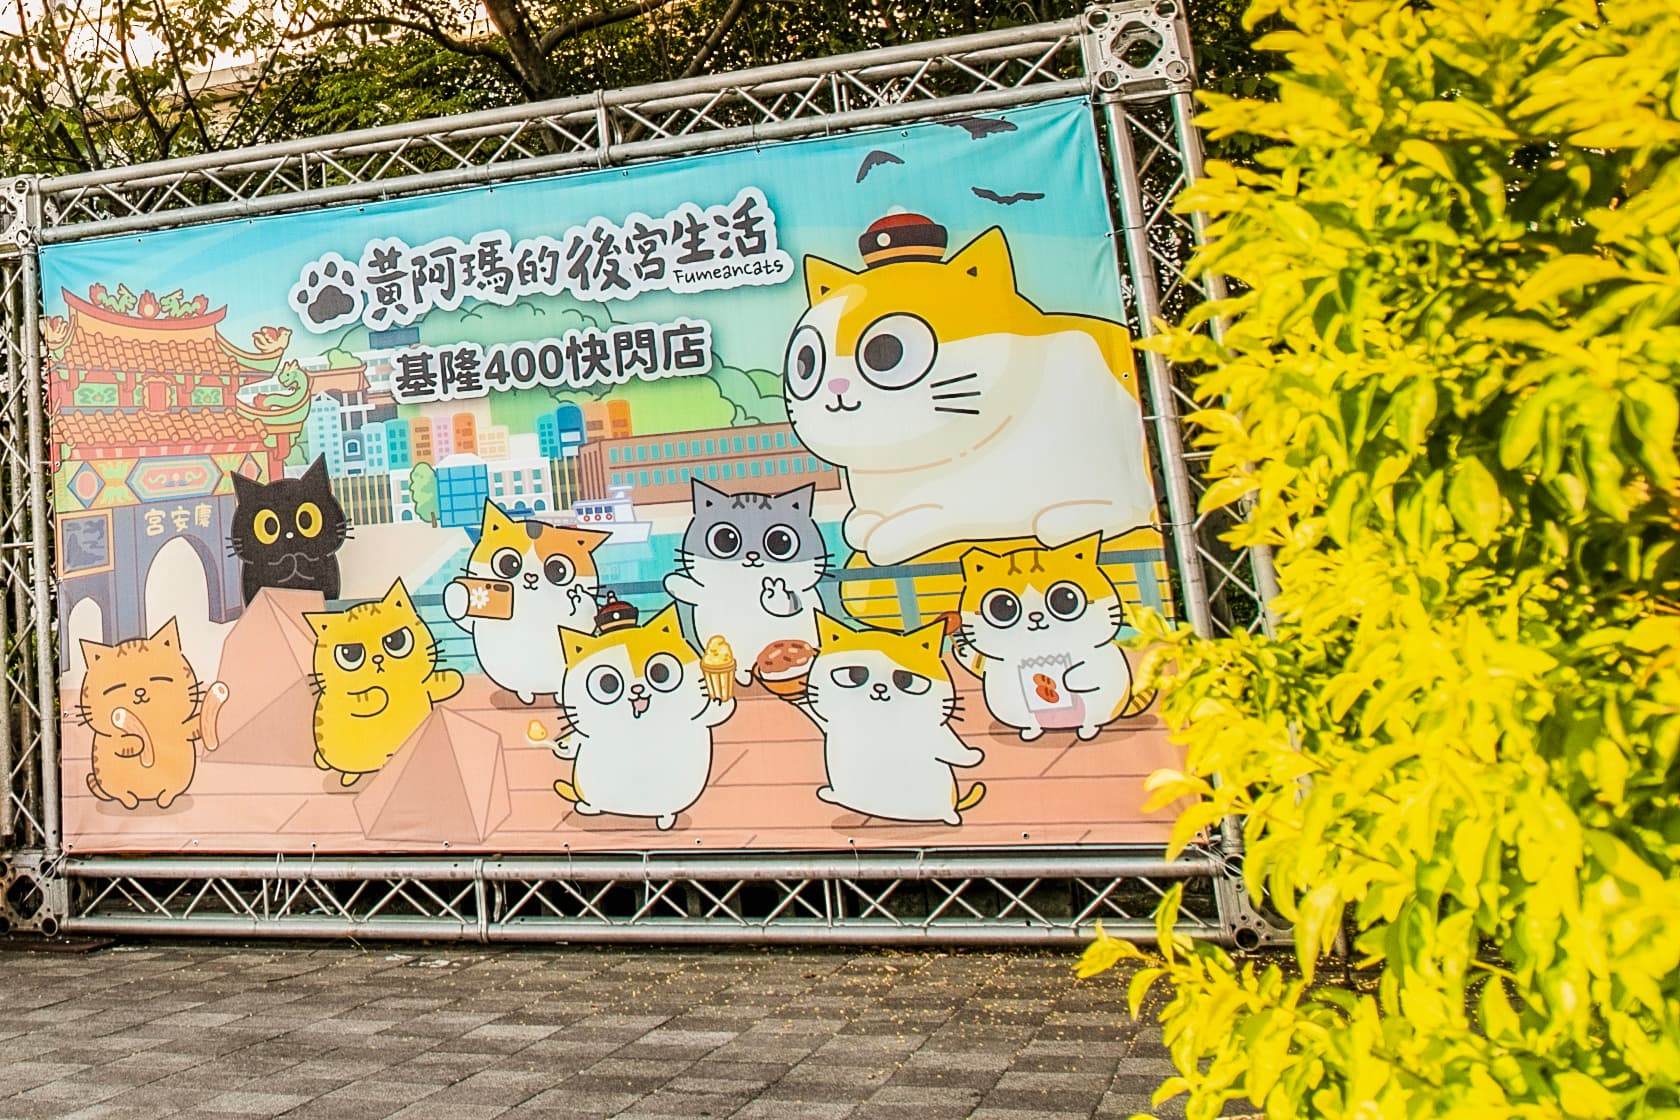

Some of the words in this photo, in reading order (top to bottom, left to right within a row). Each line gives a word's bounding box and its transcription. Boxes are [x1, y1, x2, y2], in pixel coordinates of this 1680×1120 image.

[366, 196, 767, 322] 黃阿瑪的後宮生活
[673, 259, 784, 283] Fumeancats
[395, 324, 706, 398] 基隆400快閃店
